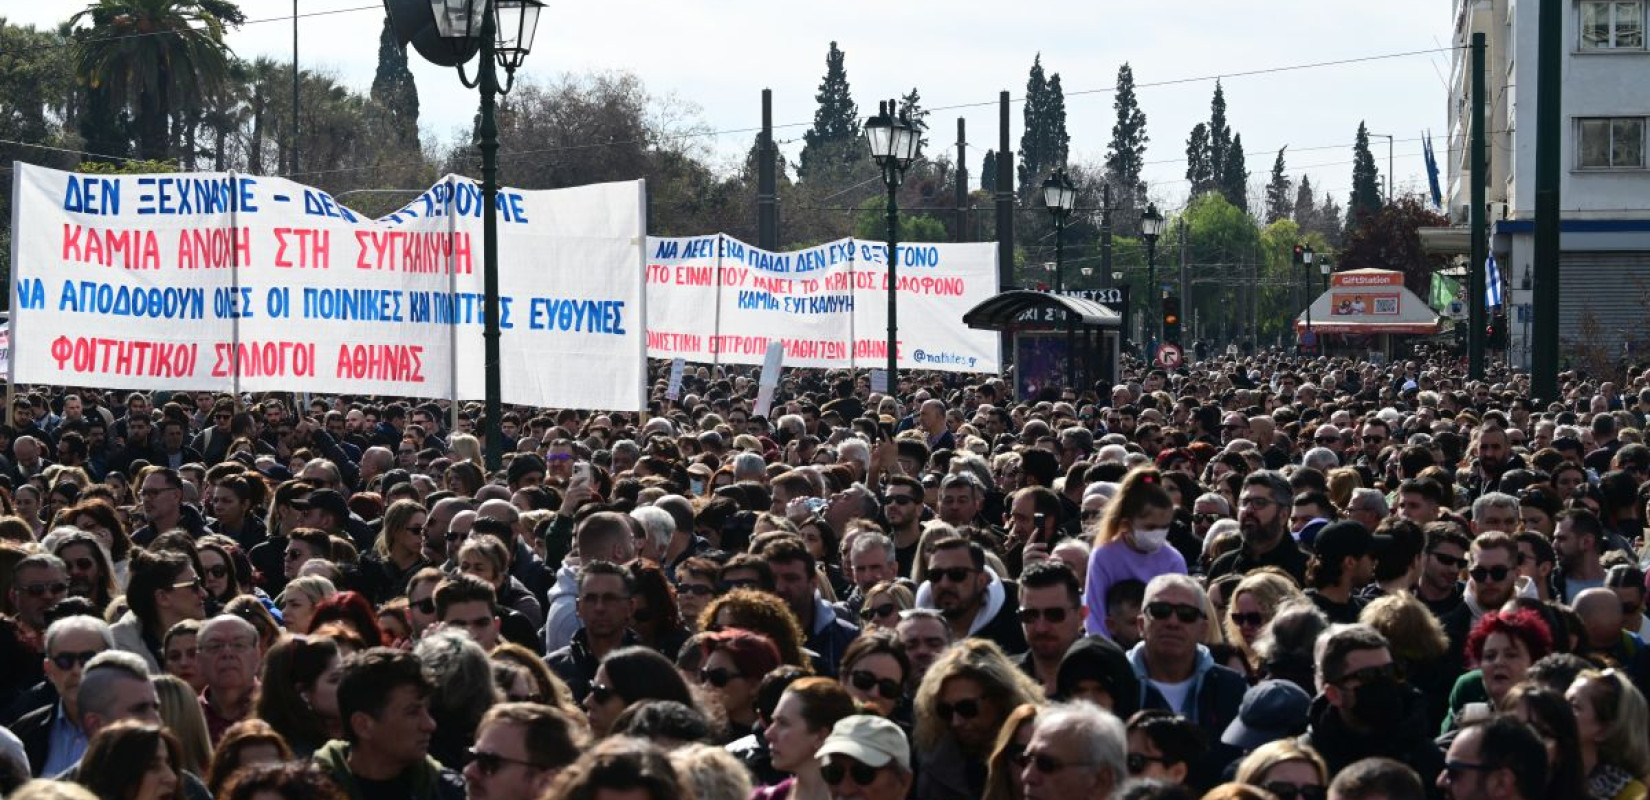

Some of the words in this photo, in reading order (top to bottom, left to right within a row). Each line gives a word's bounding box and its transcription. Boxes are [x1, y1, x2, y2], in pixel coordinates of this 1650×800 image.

[64, 175, 120, 215] ΔΕΝ
[137, 178, 258, 215] ΞΕΧΝΑΜΕ
[63, 223, 160, 269] ΚΑΜΙΑ
[178, 227, 251, 269] ΑΝΟΧΗ
[274, 228, 329, 269] ΣΤΗ
[355, 230, 472, 274] ΣΥΓΚΑΛΥΨΗ
[655, 240, 679, 259] ΝΑ
[718, 236, 745, 262] ΕΝΑ
[748, 249, 790, 273] ΠΑΙΔΙ
[796, 249, 826, 273] ΔΕΝ
[829, 240, 856, 265] ΕΧΩ
[675, 266, 713, 286] ΕΙΝΑΙ
[717, 267, 748, 287] ΠΟΥ
[800, 279, 819, 294] ΤΟ
[1341, 275, 1391, 284] GiftStation
[17, 279, 45, 310] ΝΑ
[59, 280, 204, 319] ΑΠΟΔΟΘΟΥΝ
[213, 287, 253, 318] ΟΛΕΣ
[267, 286, 289, 318] ΟΙ
[303, 287, 403, 322] ΠΟΙΝΙΚΕΣ
[409, 291, 430, 323] ΚΑΙ
[530, 297, 625, 334] ΕΥΘΥΝΕΣ
[738, 290, 779, 310] ΚΑΜΙΑ
[51, 335, 197, 378] ΦΟΙΤΗΤΙΚΟΙ
[212, 342, 315, 377] ΣΥΛΛΟΓΟΙ
[336, 344, 425, 382] ΑΘΗΝΑΣ
